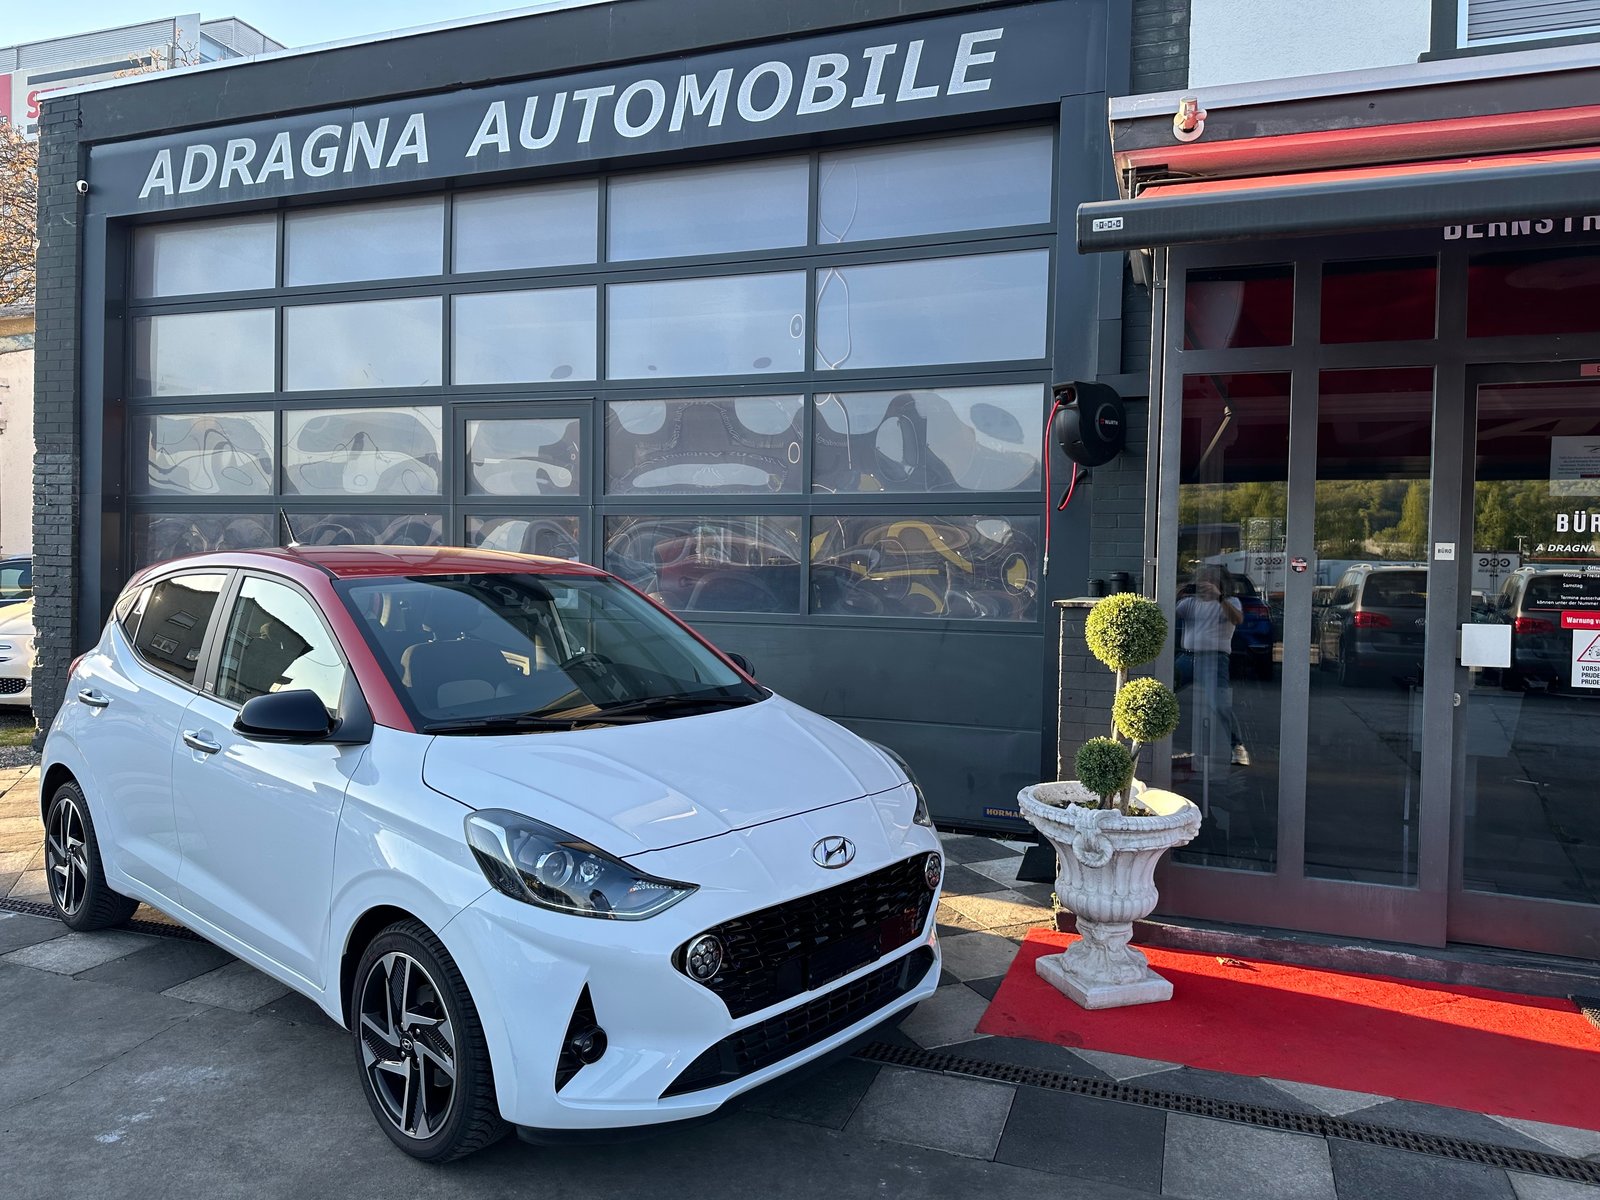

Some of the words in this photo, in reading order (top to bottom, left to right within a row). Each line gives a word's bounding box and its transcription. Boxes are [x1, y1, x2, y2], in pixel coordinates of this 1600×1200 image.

[138, 112, 429, 199] ADRAGNA
[465, 27, 1004, 158] AUTOMOBILE
[1566, 616, 1594, 625] Warnung
